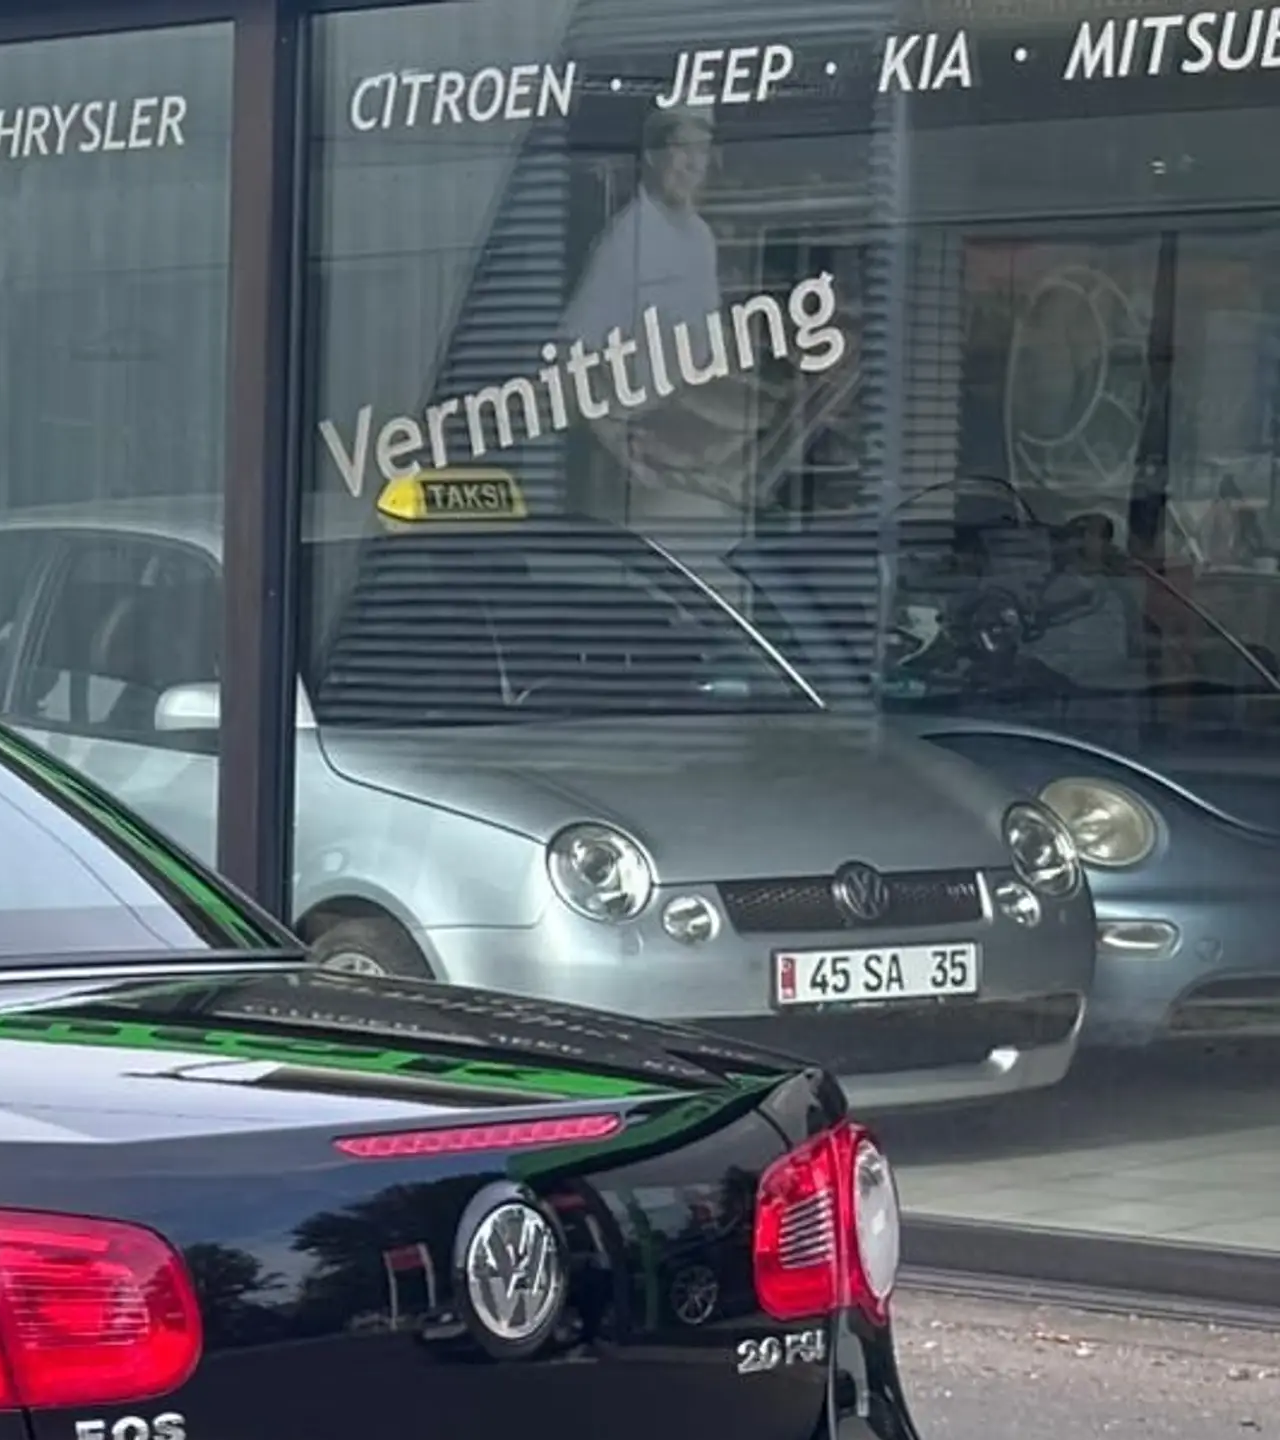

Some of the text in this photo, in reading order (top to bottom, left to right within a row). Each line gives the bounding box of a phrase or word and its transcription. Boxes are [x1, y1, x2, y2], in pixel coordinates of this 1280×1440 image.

[349, 60, 578, 131] CITROEN
[654, 43, 795, 110] JEEP
[877, 30, 974, 93] KIA
[317, 270, 845, 498] Vermittlung
[426, 482, 507, 511] TAKSI
[809, 948, 968, 996] 45 SA 35
